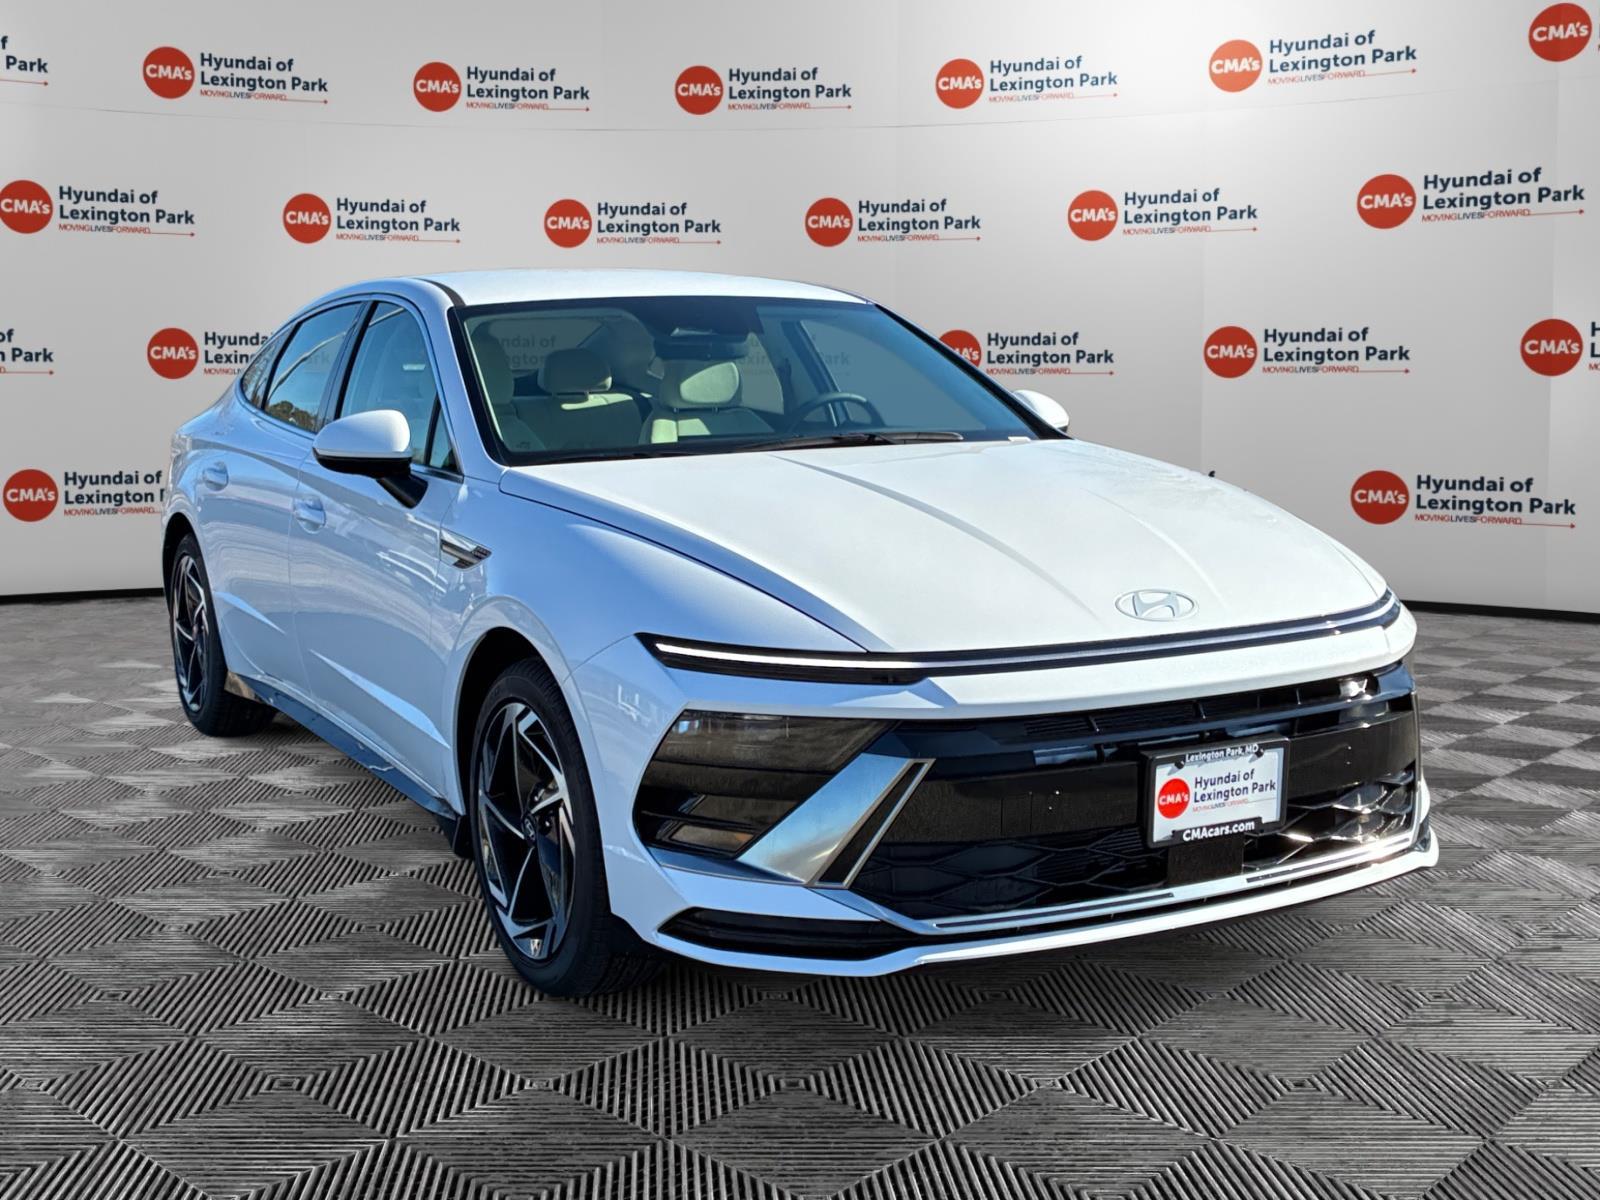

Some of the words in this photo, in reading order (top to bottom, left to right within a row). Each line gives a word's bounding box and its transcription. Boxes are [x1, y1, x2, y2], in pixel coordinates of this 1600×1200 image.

[1532, 21, 1589, 42] CMA's
[0, 35, 9, 50] f
[1269, 33, 1349, 57] Hyundai
[1353, 29, 1376, 46] of
[5, 54, 49, 74] Park
[199, 52, 272, 72] Hyundai
[275, 58, 294, 72] of
[989, 57, 1060, 78] Hyundai
[1064, 55, 1083, 70] of
[1211, 56, 1260, 74] CMA's
[1269, 53, 1366, 74] Lexington
[1371, 45, 1417, 64] Park
[145, 63, 192, 81] CMA's
[200, 70, 287, 92] Lexington
[291, 76, 329, 93] Park
[466, 65, 535, 84] Hyundai
[538, 67, 557, 82] of
[728, 67, 797, 86] Hyundai
[800, 66, 819, 81] of
[416, 79, 459, 93] CMA's
[677, 83, 721, 96] CMA's
[938, 75, 982, 91] CMA's
[989, 76, 1075, 94] Lexington
[1079, 71, 1118, 88] Park
[466, 83, 549, 103] Lexington
[553, 85, 590, 101] Park
[728, 85, 811, 103] Lexington
[815, 83, 852, 99] Park
[1423, 169, 1513, 194] Hyundai
[1517, 166, 1542, 184] of
[58, 185, 135, 205] Hyundai
[138, 190, 159, 205] of
[1124, 188, 1198, 210] Hyundai
[1201, 187, 1220, 203] of
[1360, 192, 1413, 209] CMA's
[1423, 191, 1531, 211] Lexington
[1537, 184, 1585, 204] Park
[0, 198, 50, 214] CMA's
[59, 204, 151, 226] Lexington
[155, 208, 195, 225] Park
[336, 197, 406, 216] Hyundai
[408, 199, 427, 214] of
[597, 201, 666, 220] Hyundai
[669, 201, 688, 216] of
[858, 198, 926, 218] Hyundai
[929, 198, 947, 213] of
[1070, 208, 1115, 223] CMA's
[1123, 208, 1212, 227] Lexington
[1216, 204, 1258, 221] Park
[286, 211, 329, 225] CMA's
[336, 215, 420, 234] Lexington
[423, 217, 461, 232] Park
[546, 216, 590, 230] CMA's
[807, 214, 850, 228] CMA's
[858, 217, 940, 235] Lexington
[943, 215, 981, 230] Park
[597, 219, 680, 237] Lexington
[684, 219, 722, 234] Park
[204, 331, 273, 349] Hyunda
[987, 331, 1057, 351] Hyundai
[1060, 331, 1080, 346] of
[1263, 327, 1343, 347] Hyundai
[1347, 326, 1370, 343] of
[11, 346, 54, 363] Park
[150, 346, 196, 360] CMA's
[1207, 344, 1255, 359] CMA's
[1263, 347, 1360, 366] Lexington
[1365, 345, 1410, 362] Park
[1524, 339, 1580, 355] CMA's
[986, 350, 1071, 368] Lexington
[1075, 349, 1114, 364] Park
[63, 470, 140, 490] Hyundai
[143, 470, 163, 485] of
[1416, 474, 1505, 495] Hyundai
[1509, 477, 1534, 493] of
[6, 487, 55, 502] CMA's
[64, 489, 155, 508] Lexington
[1354, 489, 1407, 505] CMA's
[1415, 493, 1523, 516] Lexington
[1529, 497, 1576, 516] Park
[1185, 749, 1225, 763] Lexington
[1194, 771, 1241, 790] Hyundai
[1243, 768, 1255, 782] of
[1158, 793, 1190, 807] CMA's
[1193, 785, 1249, 803] Lexington
[1251, 780, 1276, 794] Park
[1182, 820, 1255, 842] CMAcars.com
